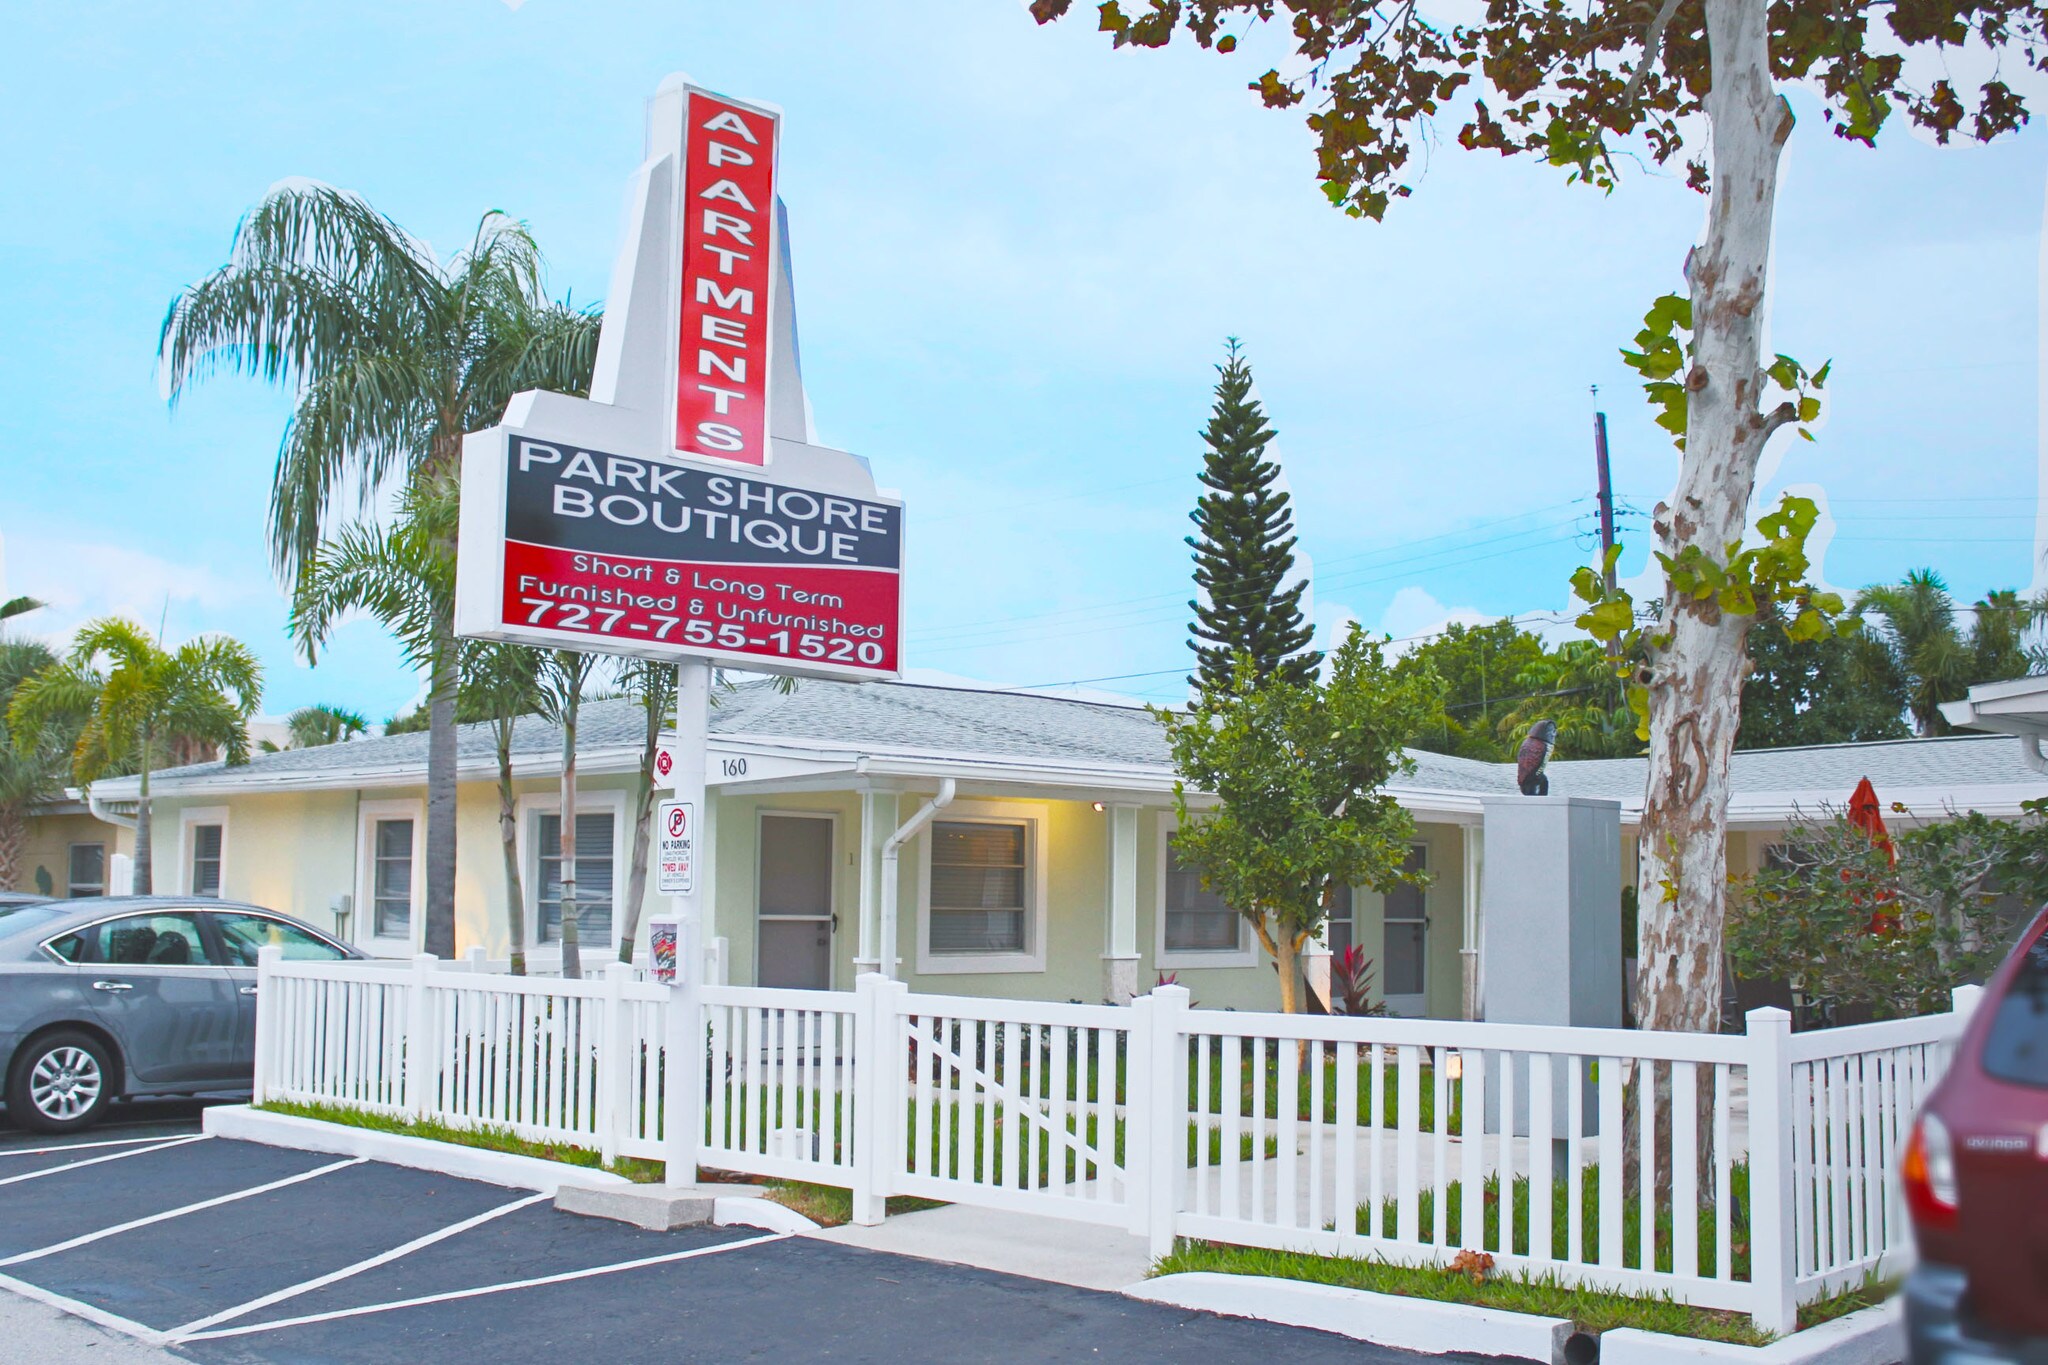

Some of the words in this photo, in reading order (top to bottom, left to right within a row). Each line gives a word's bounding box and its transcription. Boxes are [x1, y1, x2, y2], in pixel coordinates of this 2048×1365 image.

[694, 110, 759, 453] APARTMENTS
[519, 440, 687, 500] PARK
[707, 477, 888, 535] SHORE
[553, 484, 859, 563] BOUTIQUE
[518, 574, 677, 612] Furnished
[689, 598, 704, 616] &
[716, 601, 885, 639] Unfurnished
[573, 554, 653, 581] Short
[665, 568, 681, 585] &
[693, 571, 765, 603] Long
[775, 583, 843, 609] Term
[521, 597, 884, 665] 727-755-1520
[722, 758, 747, 776] 160
[662, 841, 669, 850] NO
[671, 839, 690, 850] PARKING
[662, 862, 676, 872] TOWED
[678, 862, 689, 872] AWAY
